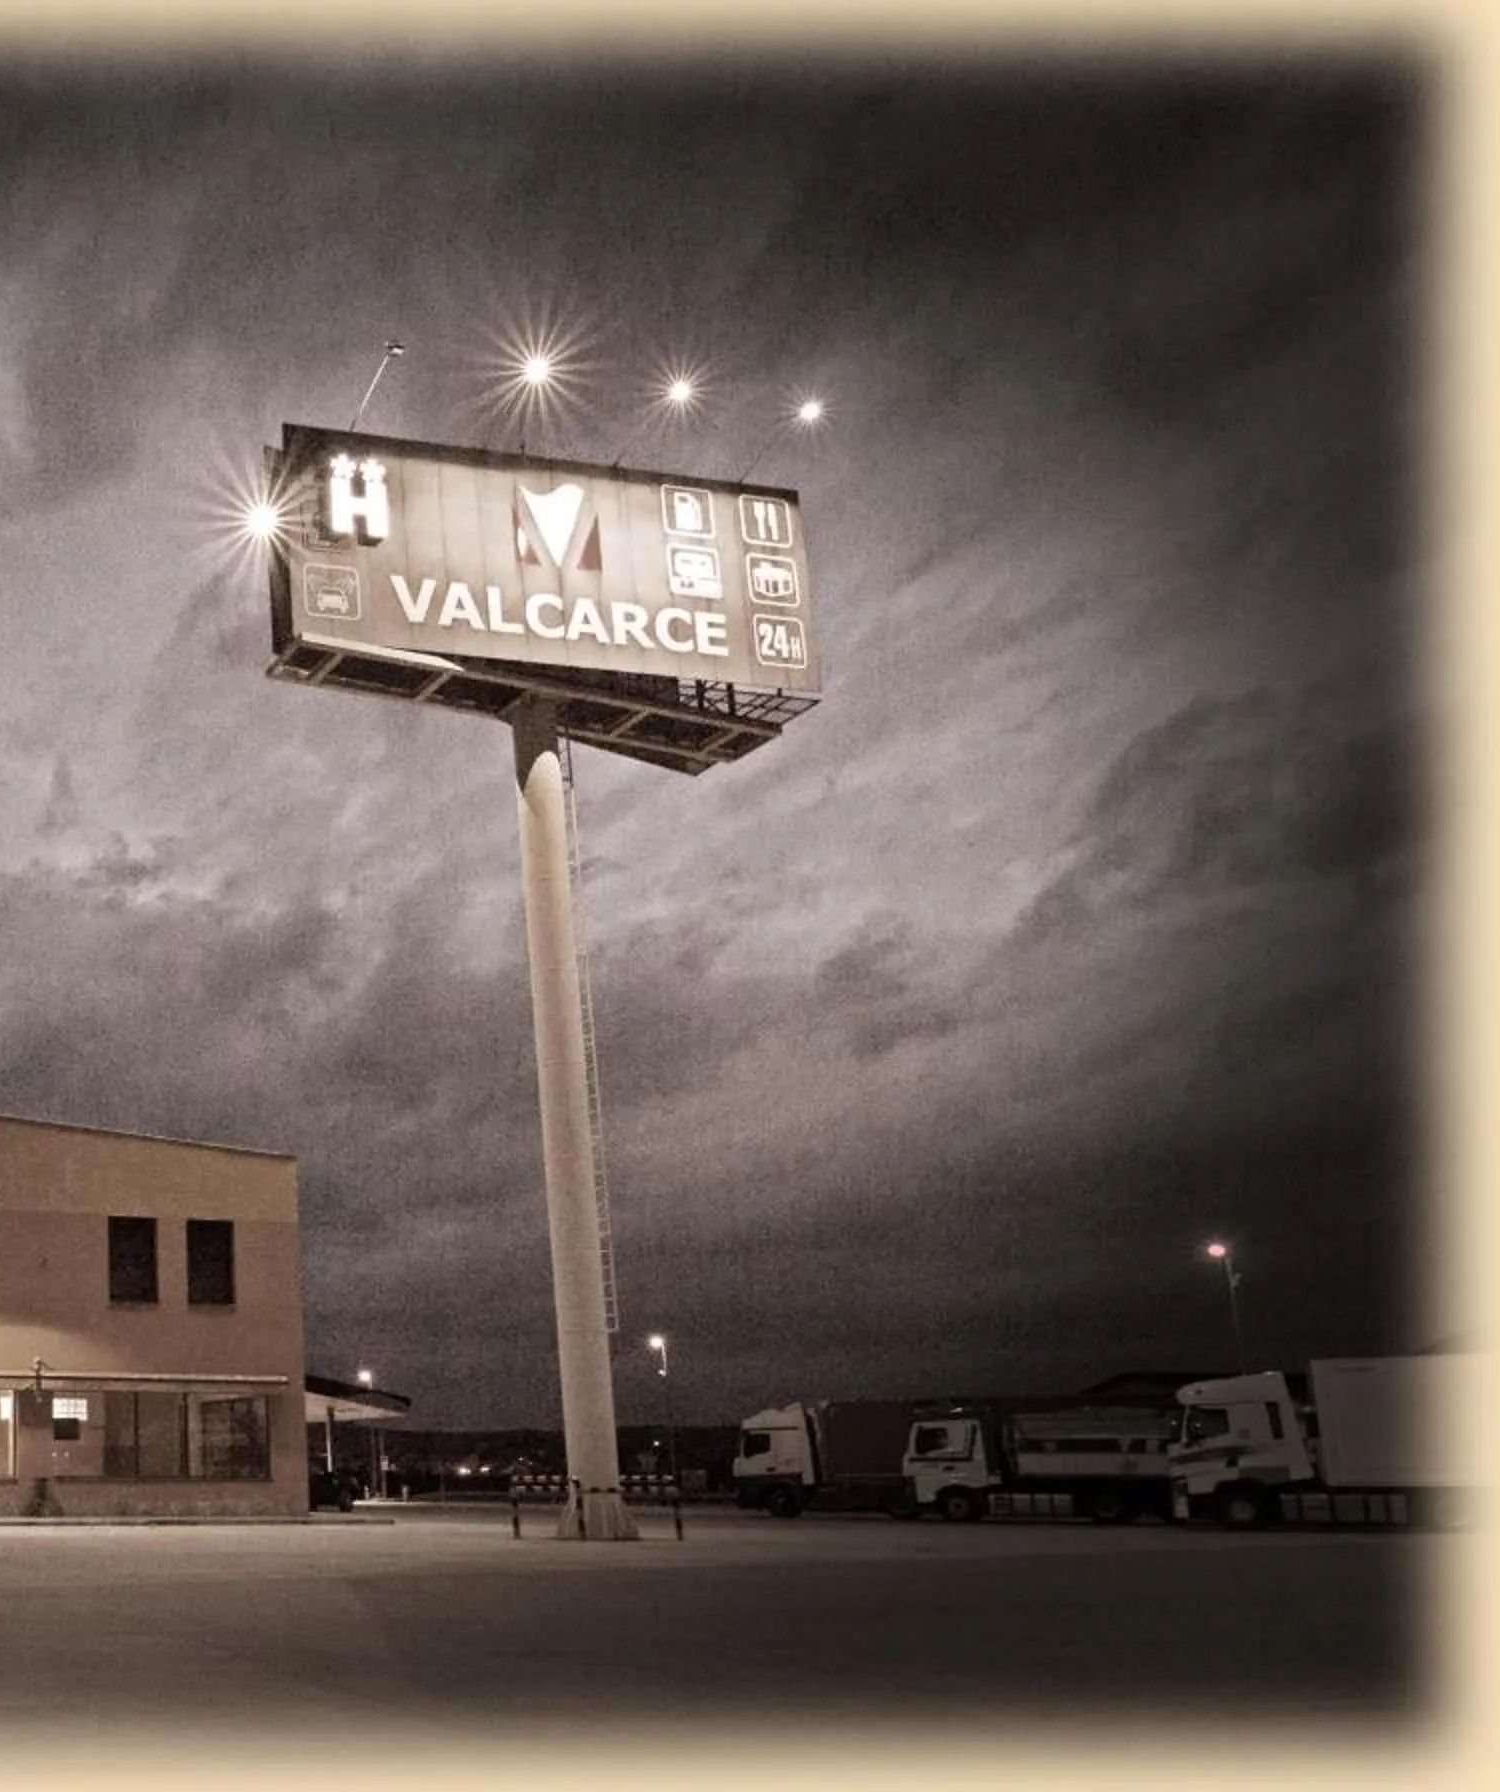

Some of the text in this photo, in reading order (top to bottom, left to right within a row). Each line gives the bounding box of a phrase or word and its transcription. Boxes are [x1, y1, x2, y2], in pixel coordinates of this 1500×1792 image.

[330, 476, 389, 538] H
[390, 575, 729, 656] VALCARCE
[759, 624, 801, 659] 24H
